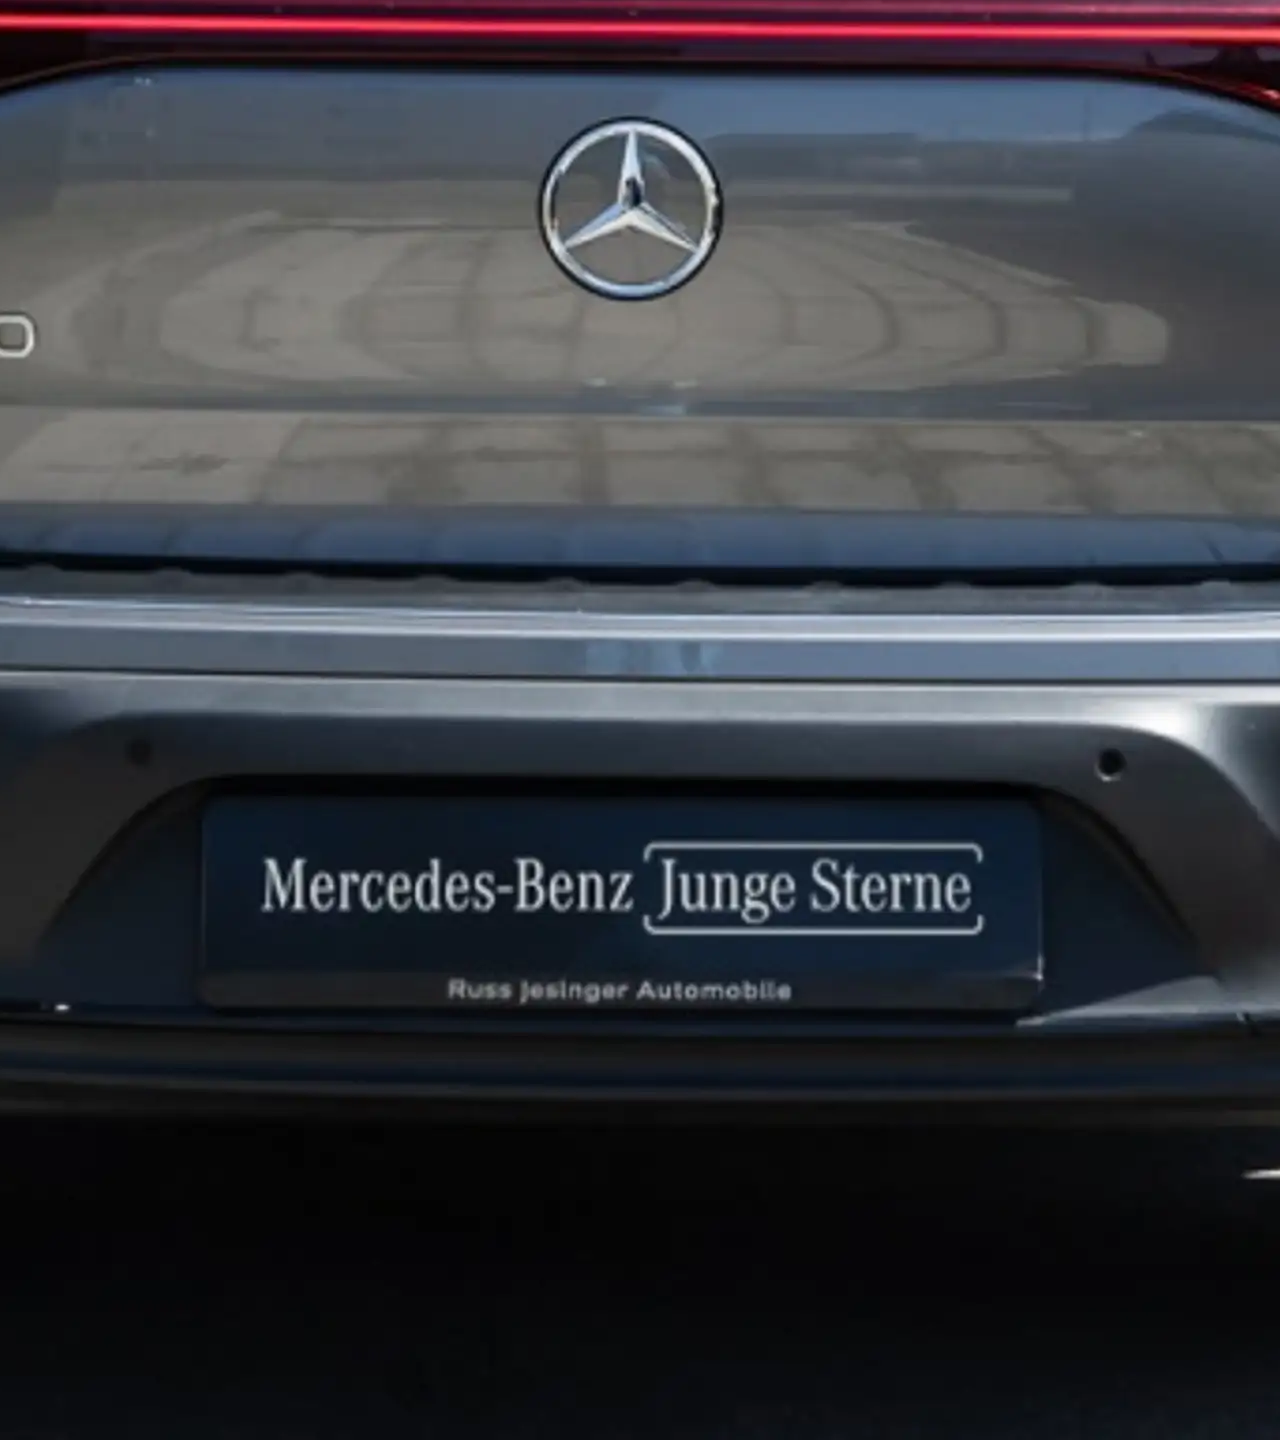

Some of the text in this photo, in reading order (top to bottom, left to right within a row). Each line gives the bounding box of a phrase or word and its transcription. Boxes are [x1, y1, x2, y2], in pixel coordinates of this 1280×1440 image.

[261, 857, 972, 924] Mercedes-Benz Junge Sterne
[447, 978, 793, 1005] Russ Jesinger Automobile
